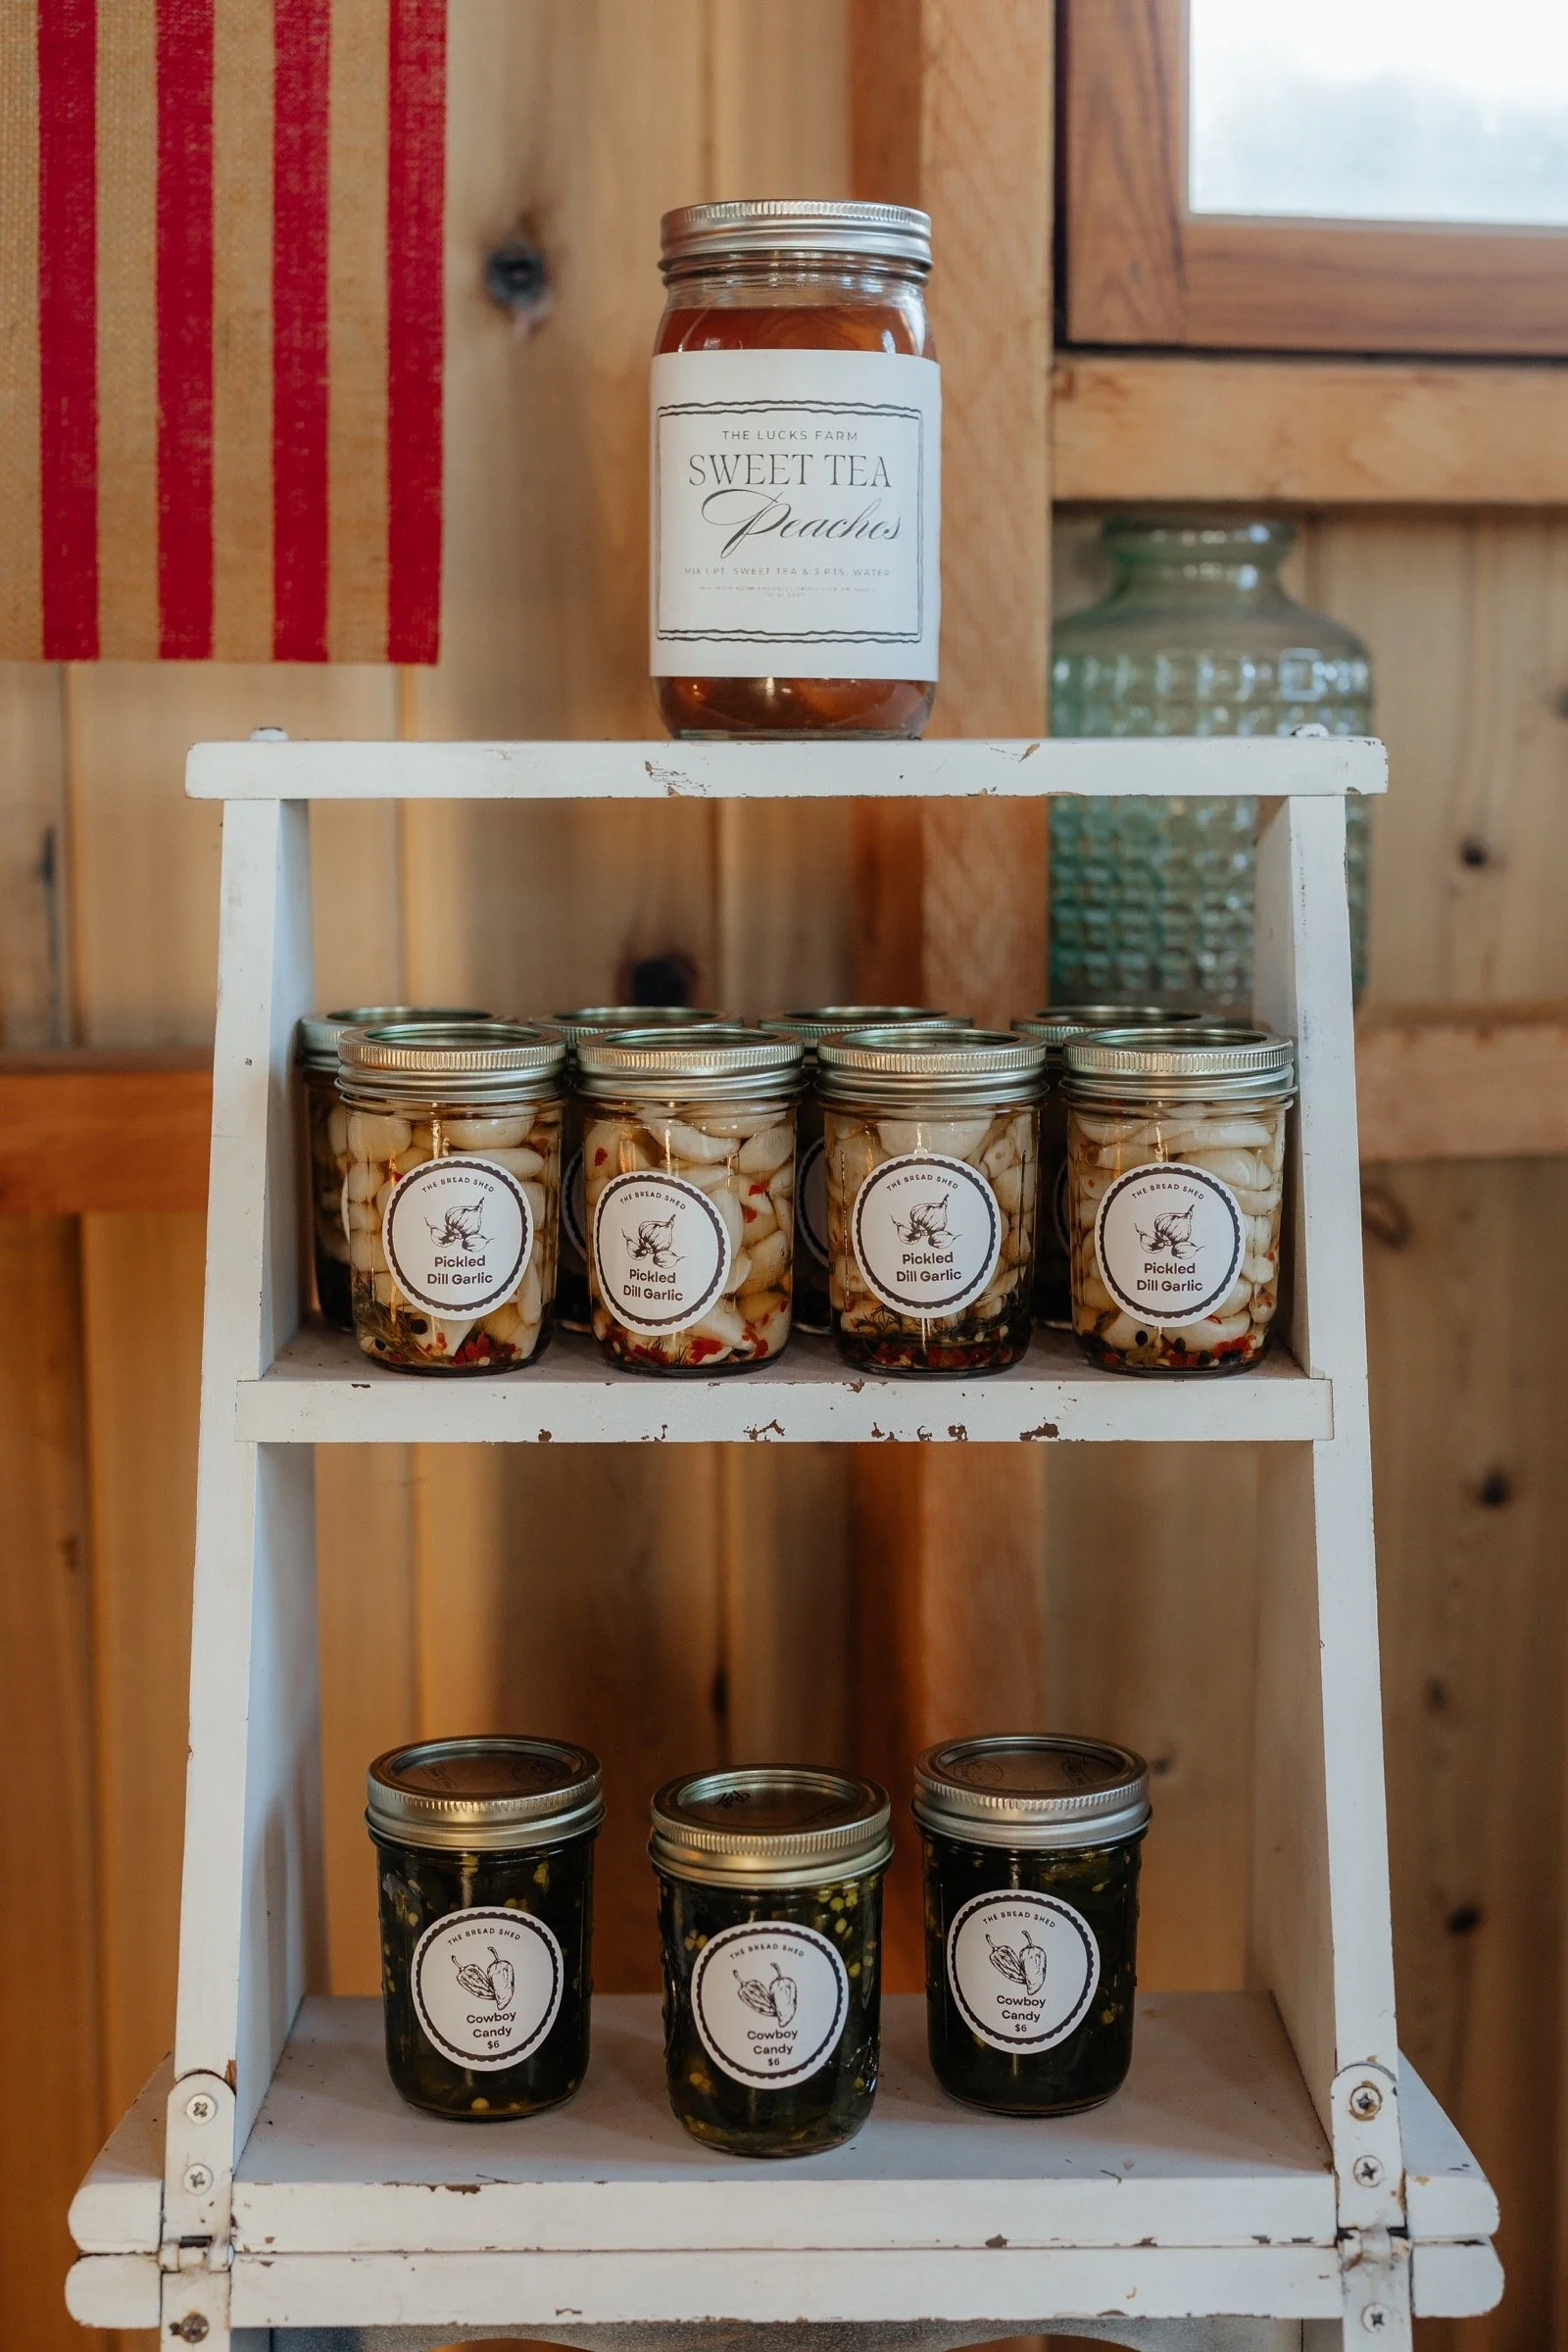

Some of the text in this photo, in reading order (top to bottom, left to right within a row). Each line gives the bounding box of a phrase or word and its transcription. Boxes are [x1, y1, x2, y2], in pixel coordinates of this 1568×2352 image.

[722, 430, 858, 441] THE LUCKS FARM
[689, 454, 892, 488] SWEET TEA
[702, 488, 904, 559] Peaches
[684, 566, 702, 575] MIX
[421, 1177, 495, 1194] THE BREAD SHED
[886, 1174, 958, 1192] THE BREAD SHED
[1132, 1183, 1204, 1200] THE BREAD SHED
[619, 1193, 633, 1204] THE
[664, 1195, 686, 1210] SHED
[434, 1255, 486, 1268] Pickled
[903, 1251, 954, 1264] Pickled
[1144, 1262, 1196, 1274] Pickled
[427, 1272, 493, 1285] Dill Garlic
[629, 1269, 676, 1284] Pickled
[896, 1269, 962, 1282] Dill Garlic
[1137, 1280, 1203, 1292] Dill Garlic
[623, 1285, 684, 1301] Dill Garlic
[982, 1910, 1056, 1929] THE BREAD SHED
[447, 1928, 521, 1946] THE BREAD SHED
[729, 1943, 805, 1960] THE BREAD SHED
[996, 1994, 1047, 2009] Cowboy
[466, 2011, 516, 2024] Cowboy
[1002, 2009, 1041, 2023] Candy
[472, 2026, 513, 2038] Candy
[747, 2030, 799, 2040] Cowboy
[1014, 2024, 1027, 2033] $6
[487, 2039, 500, 2050] $6
[753, 2044, 794, 2055] Candy
[767, 2057, 780, 2067] $6
